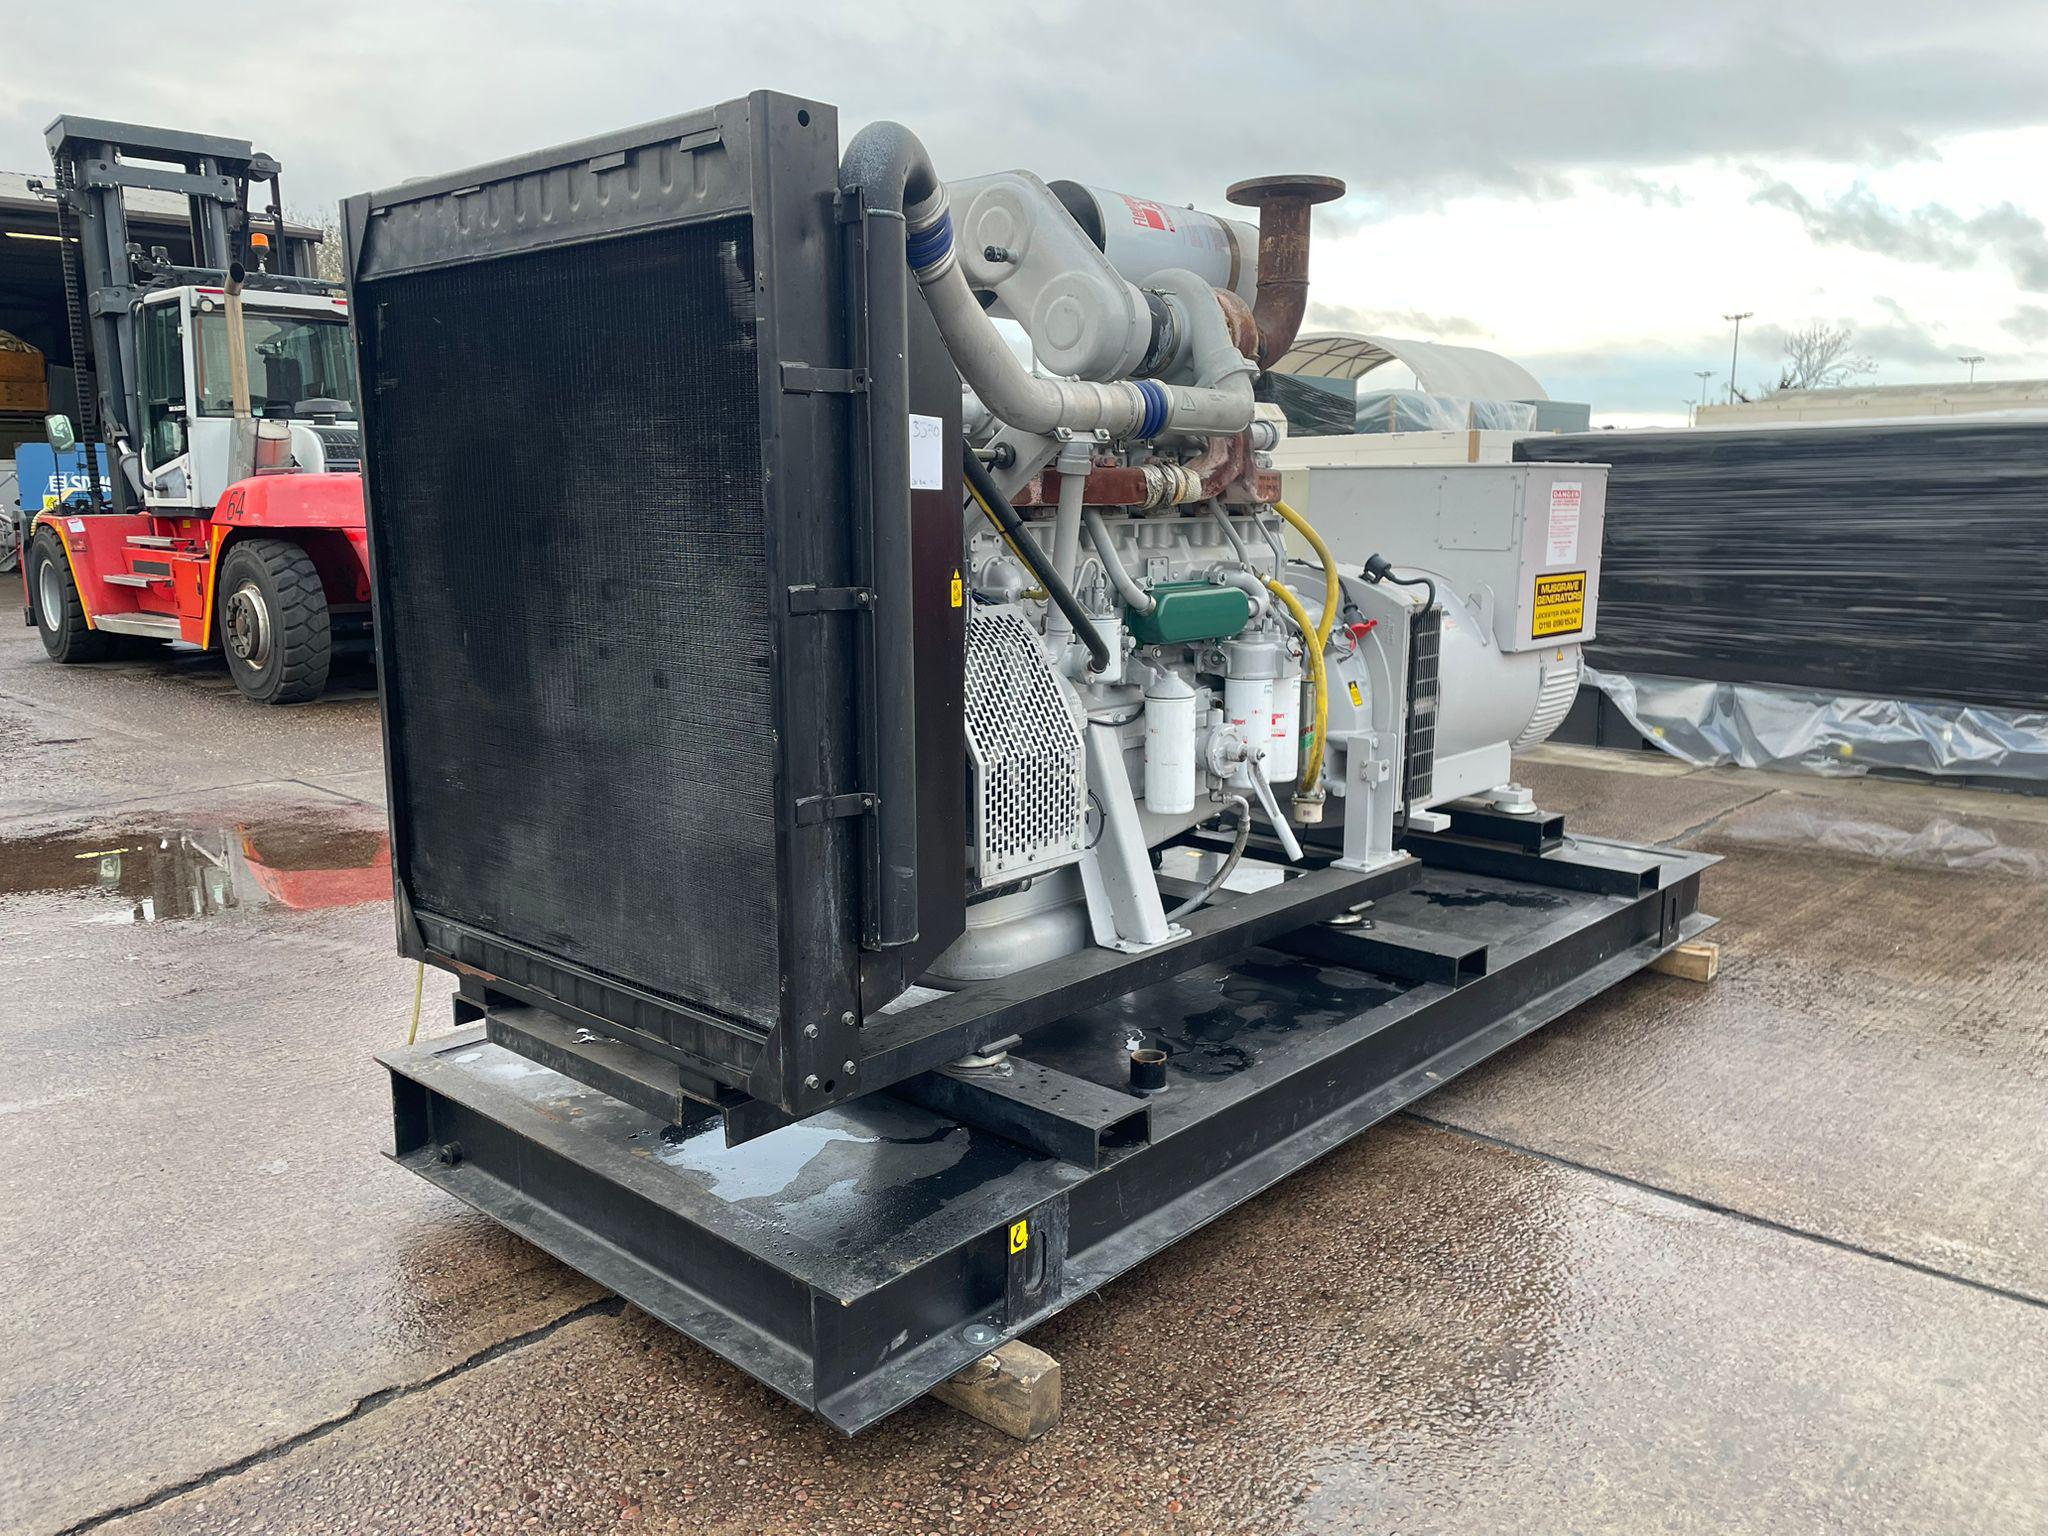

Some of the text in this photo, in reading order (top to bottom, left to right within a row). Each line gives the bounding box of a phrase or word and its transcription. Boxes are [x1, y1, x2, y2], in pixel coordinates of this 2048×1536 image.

[1553, 490, 1579, 499] DANGER
[227, 491, 246, 521] 64
[1540, 581, 1580, 594] MUSGRAVE
[1537, 591, 1582, 605] GENERATORS
